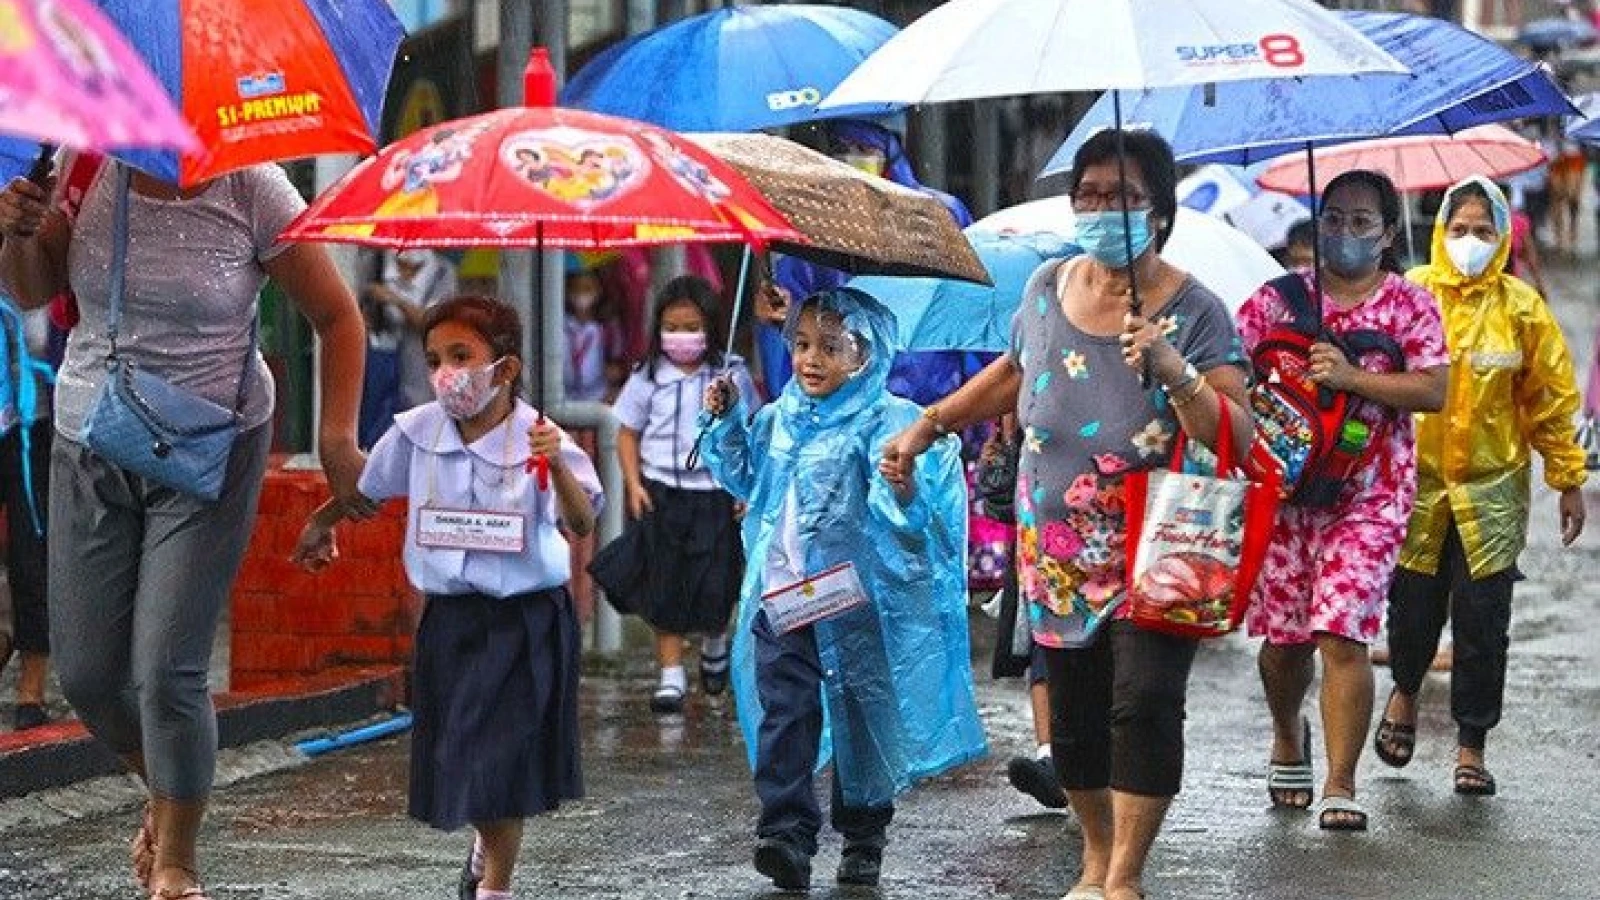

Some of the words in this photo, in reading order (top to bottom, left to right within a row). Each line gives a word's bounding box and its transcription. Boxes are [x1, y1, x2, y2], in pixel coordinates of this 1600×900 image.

[1175, 44, 1258, 60] SUPER
[1260, 34, 1304, 67] 8
[765, 87, 820, 111] BDO
